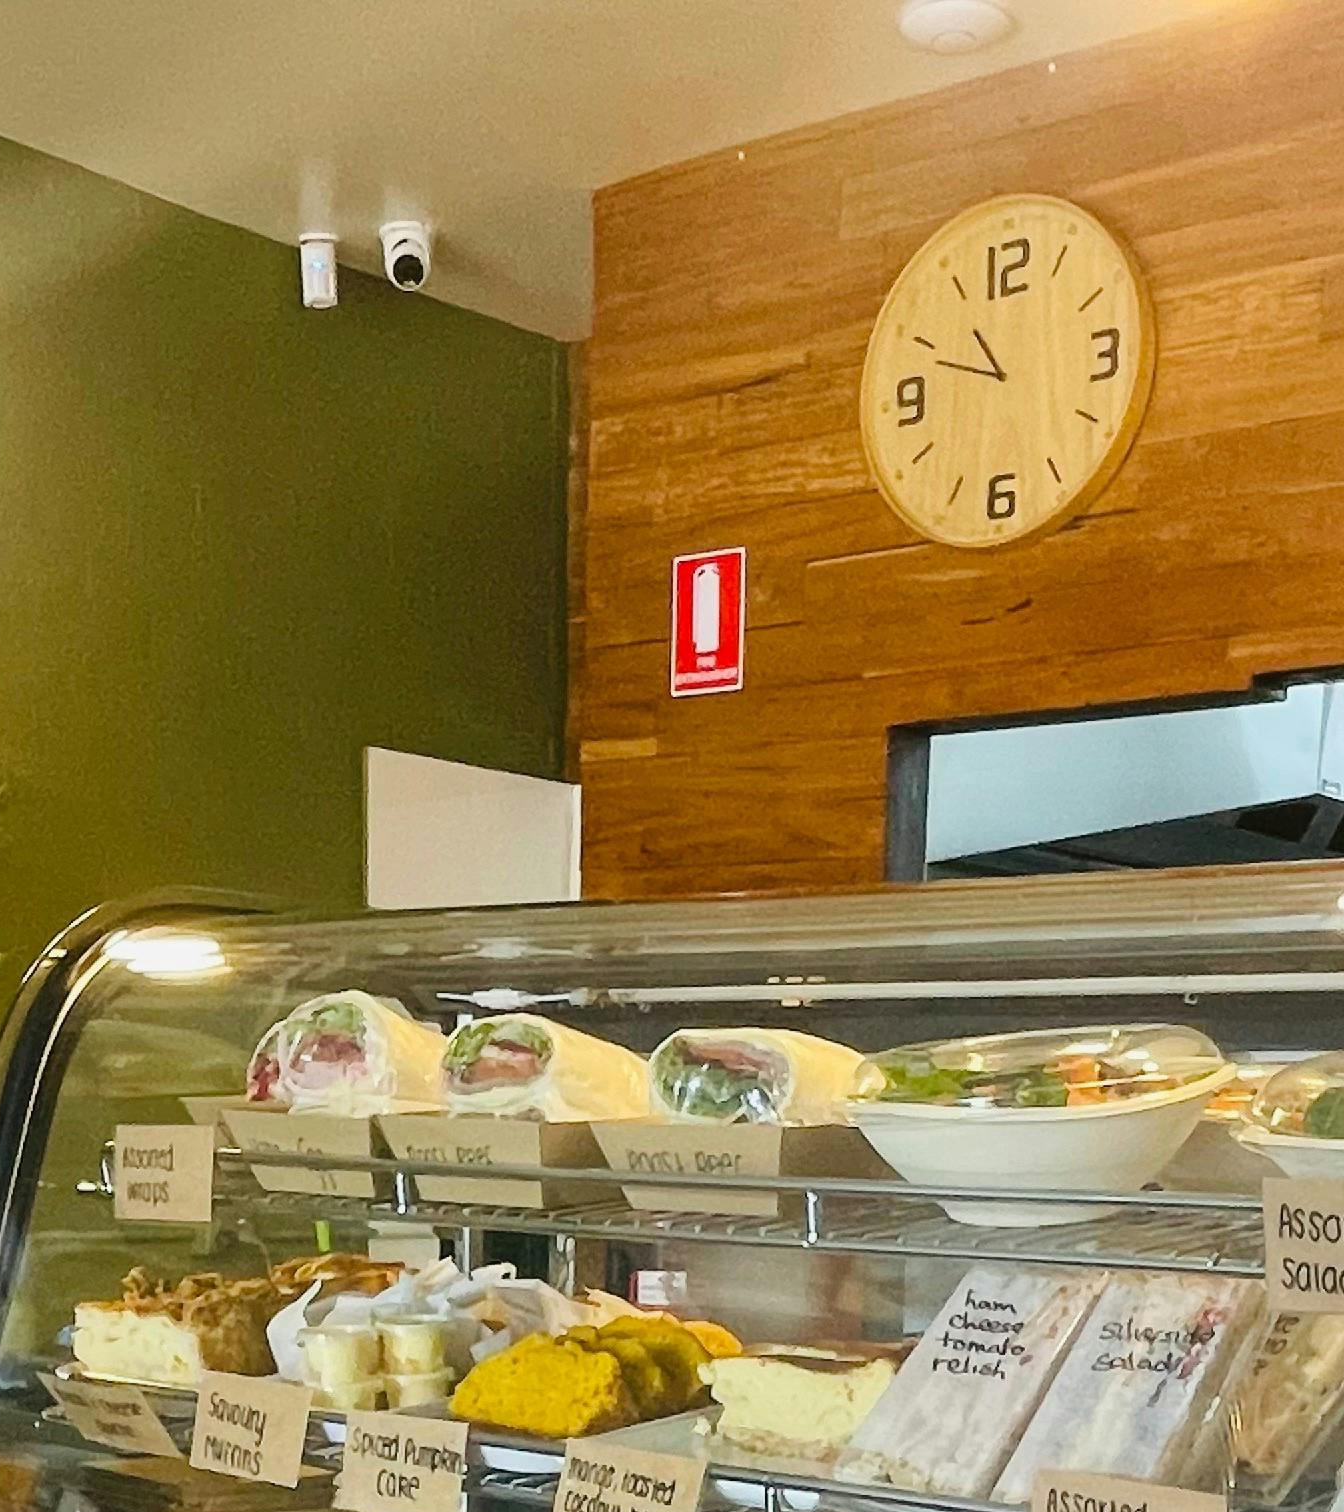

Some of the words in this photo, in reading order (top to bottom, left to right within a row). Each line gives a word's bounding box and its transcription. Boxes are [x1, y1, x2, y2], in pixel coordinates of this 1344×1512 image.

[987, 237, 1031, 300] 12
[1090, 327, 1120, 383] 3
[896, 375, 926, 428] 9
[986, 472, 1017, 520] 6
[965, 1288, 1017, 1314] ham
[931, 1355, 1006, 1380] relish
[935, 1331, 1026, 1356] tomato
[208, 1392, 267, 1447] Savoury
[352, 1426, 400, 1462] Spiced
